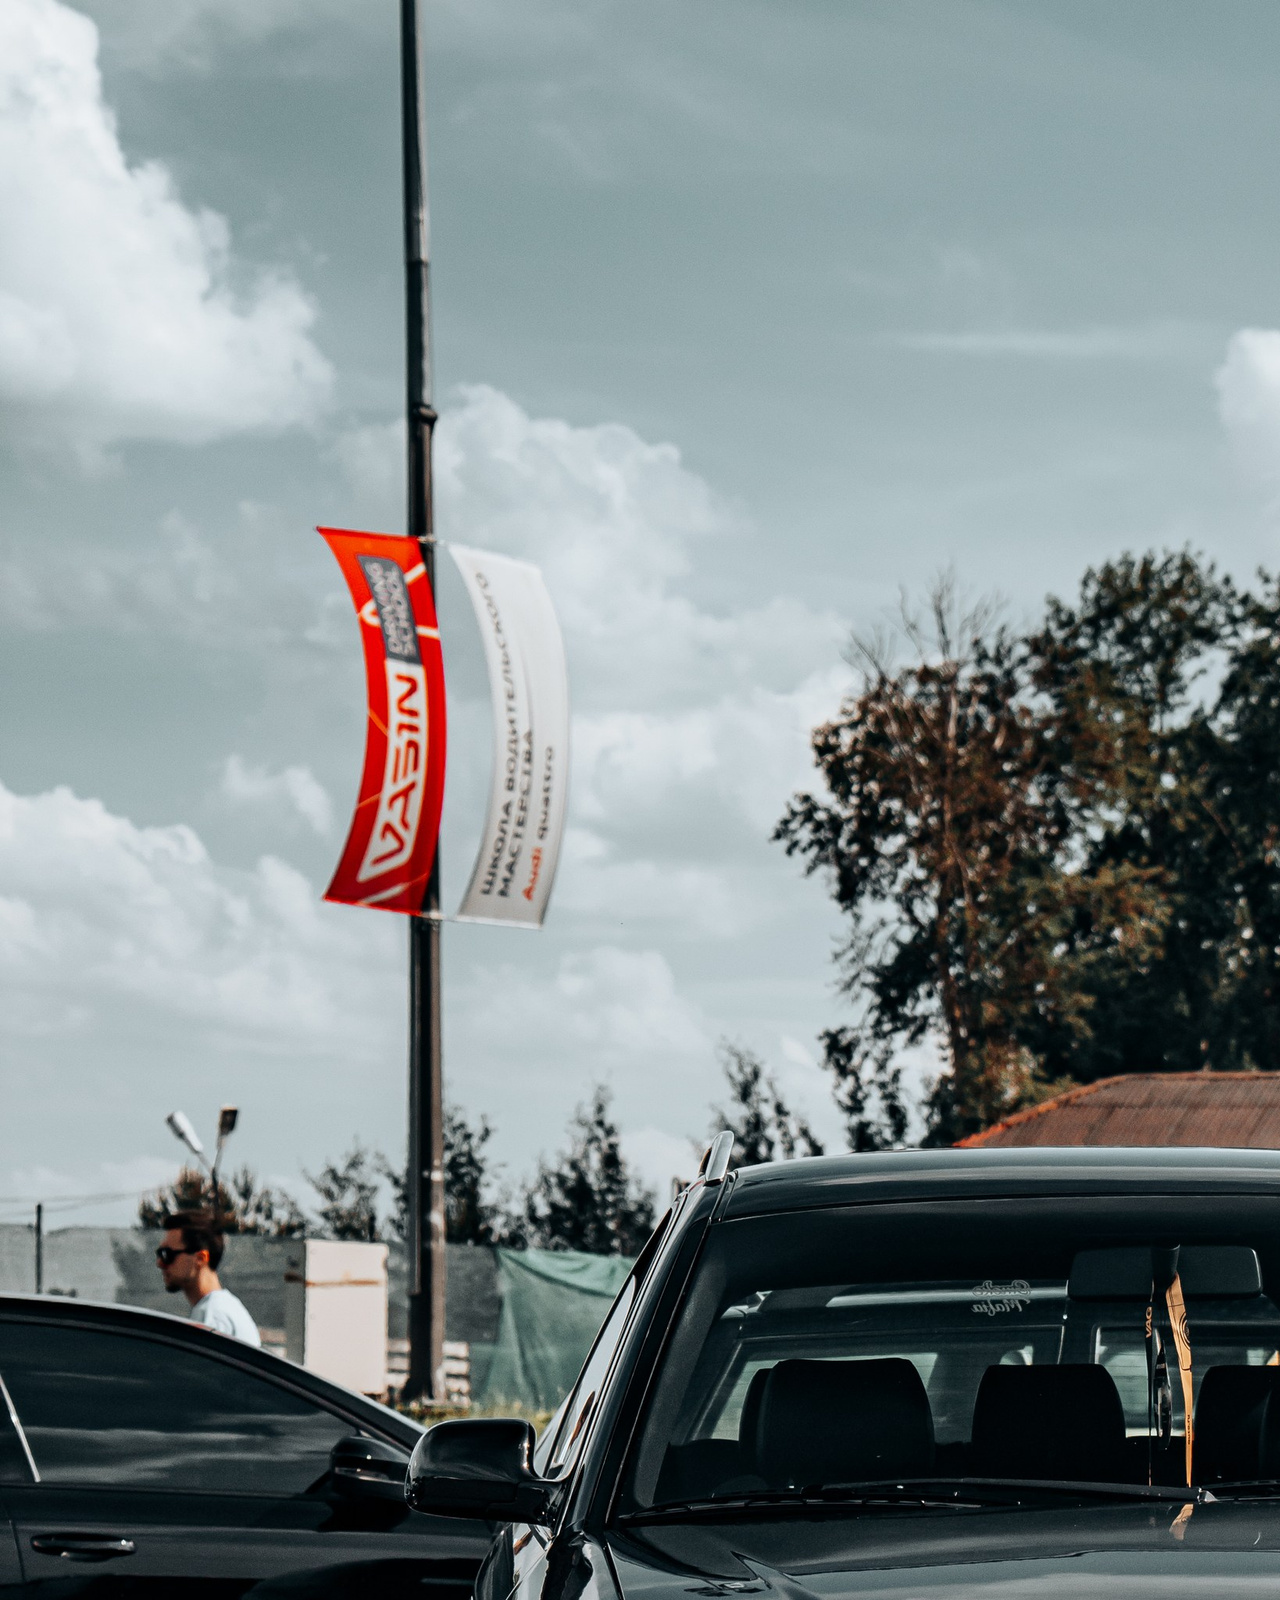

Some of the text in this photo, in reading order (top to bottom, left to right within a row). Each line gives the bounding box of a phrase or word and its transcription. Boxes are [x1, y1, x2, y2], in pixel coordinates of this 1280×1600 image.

[365, 562, 402, 654] DRIVING
[385, 564, 417, 656] SCHOOL
[369, 673, 420, 868] VASIN
[475, 571, 519, 896] ШКОЛА ВОДИТЕЛЬСКОГО
[498, 730, 533, 898] МАСТЕРСТВА
[522, 745, 555, 901] Audi quattro
